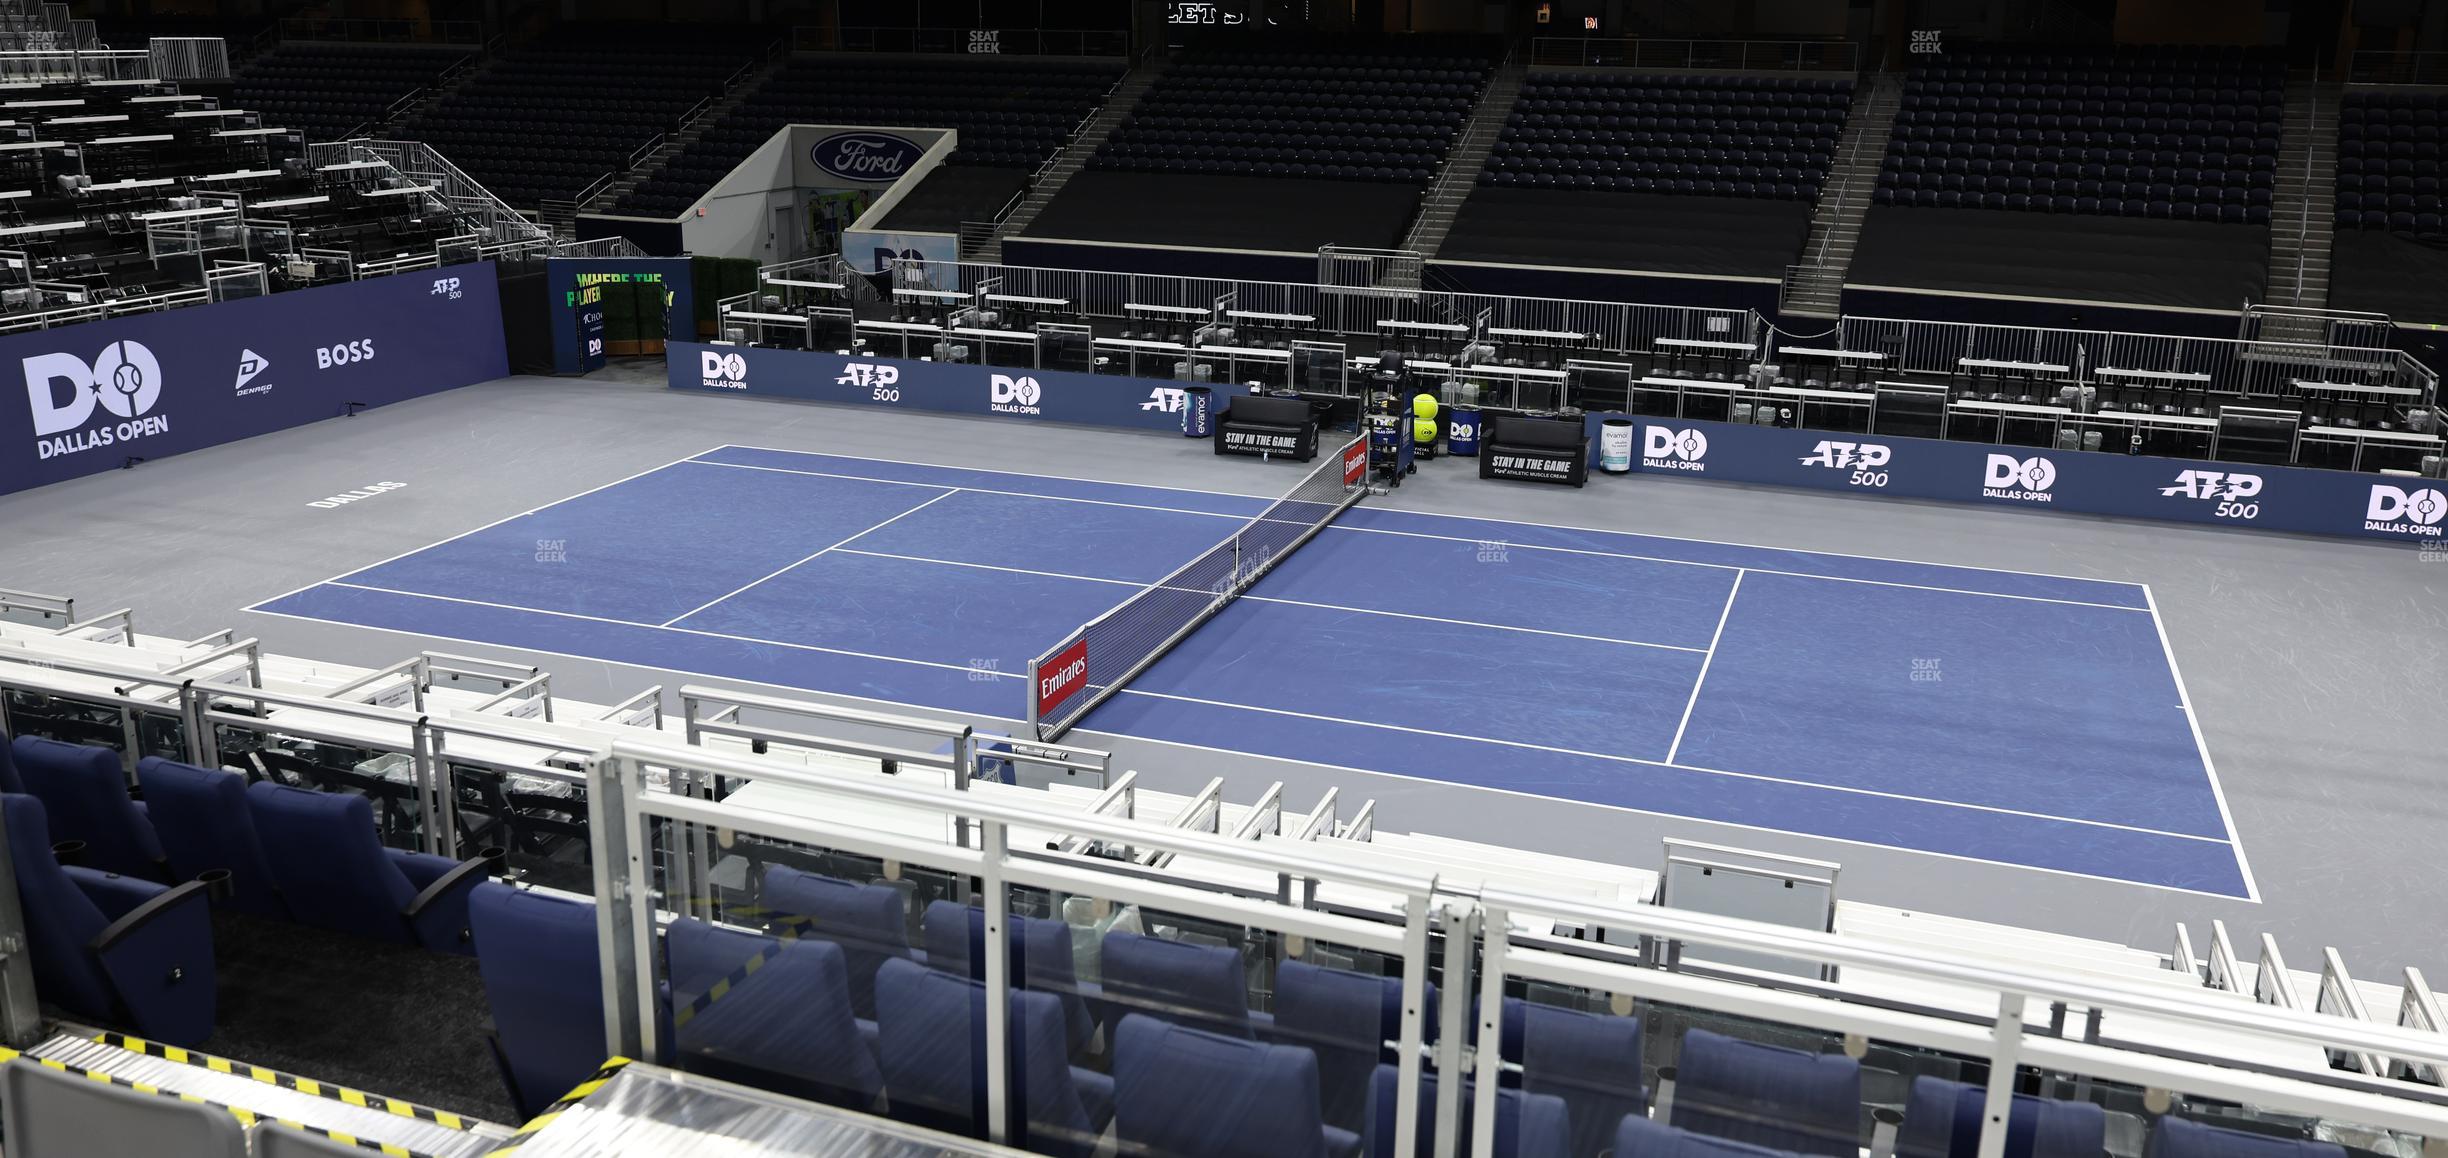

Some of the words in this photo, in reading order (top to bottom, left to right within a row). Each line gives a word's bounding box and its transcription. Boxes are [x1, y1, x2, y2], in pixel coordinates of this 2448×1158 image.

[834, 139, 902, 174] Ford
[430, 277, 460, 295] ATP
[449, 290, 462, 300] 500
[316, 338, 375, 370] BOSS
[834, 362, 899, 388] ATP
[236, 384, 272, 398] DENAGO
[702, 378, 728, 388] DALLAS
[728, 380, 747, 390] OPEN
[872, 388, 899, 402] 500
[991, 403, 1018, 413] DALLAS
[1019, 406, 1040, 415] OPEN
[1198, 396, 1206, 434] evamor
[37, 426, 115, 460] DALLAS
[116, 414, 169, 443] OPEN
[1225, 432, 1245, 444] STAY
[1245, 433, 1256, 445] IN
[1257, 434, 1272, 447] THE
[1272, 436, 1297, 448] GAME
[1492, 455, 1515, 467] STAY
[1514, 457, 1526, 469] IN
[1526, 458, 1543, 471] THE
[1543, 460, 1571, 473] GAME
[1797, 440, 1891, 471] ATP
[1643, 458, 1677, 469] DALLAS
[1678, 461, 1704, 471] OPEN
[1849, 471, 1888, 487] 500
[2157, 469, 2263, 501] ATP
[305, 481, 408, 509] DALLAS
[1983, 488, 2021, 499] DALLAS
[2022, 491, 2052, 502] OPEN
[2214, 502, 2259, 519] 500
[2364, 520, 2408, 533] DALLAS
[2409, 525, 2442, 536] OPEN
[1042, 656, 1085, 700] Emirates
